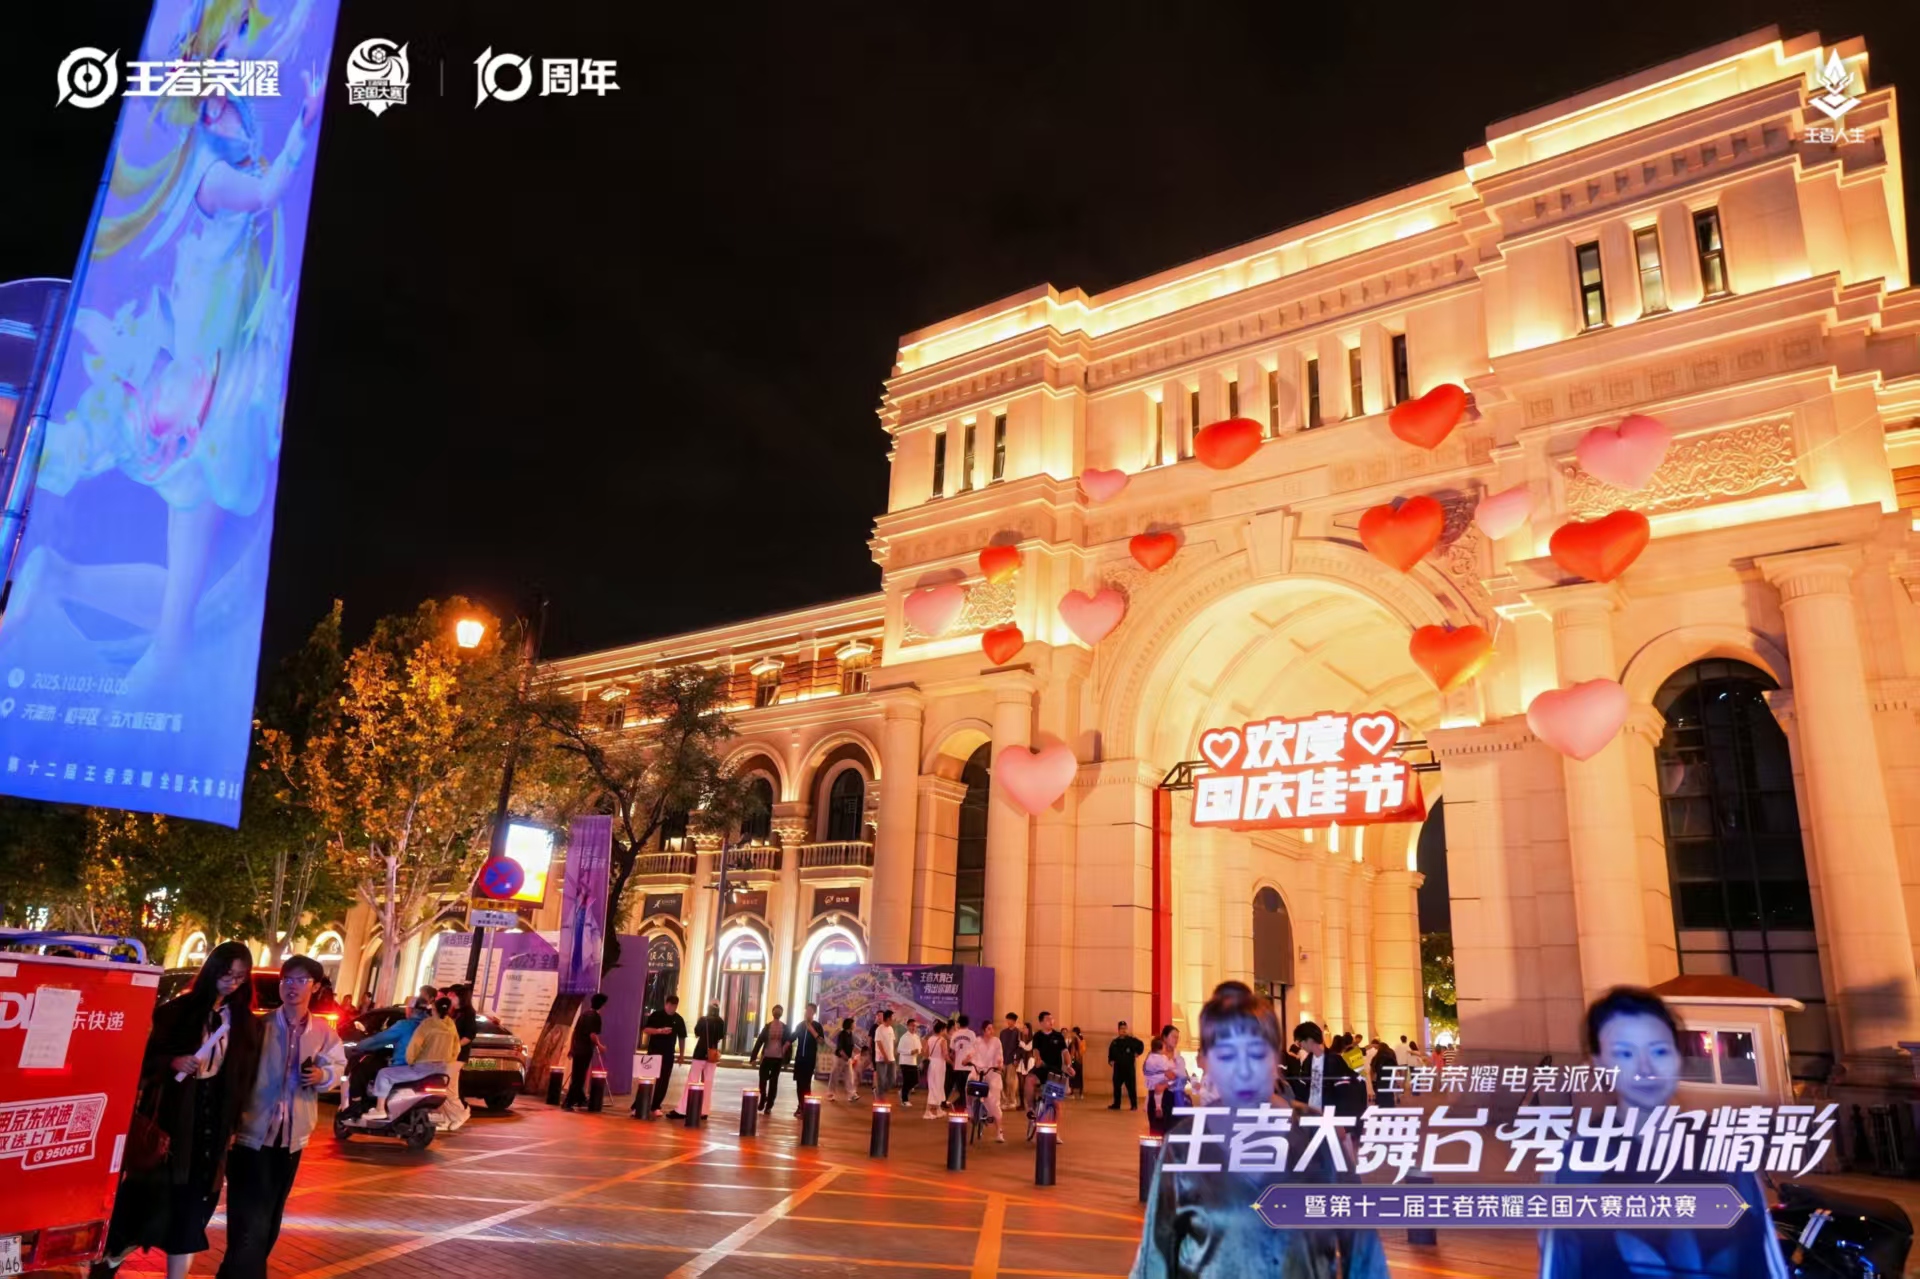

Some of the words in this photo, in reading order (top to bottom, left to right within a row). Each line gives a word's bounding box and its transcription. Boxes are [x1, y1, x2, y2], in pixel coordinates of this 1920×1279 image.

[1241, 715, 1348, 769] 欢度
[1194, 761, 1405, 823] 国庆佳节
[44, 1142, 87, 1160] 950616
